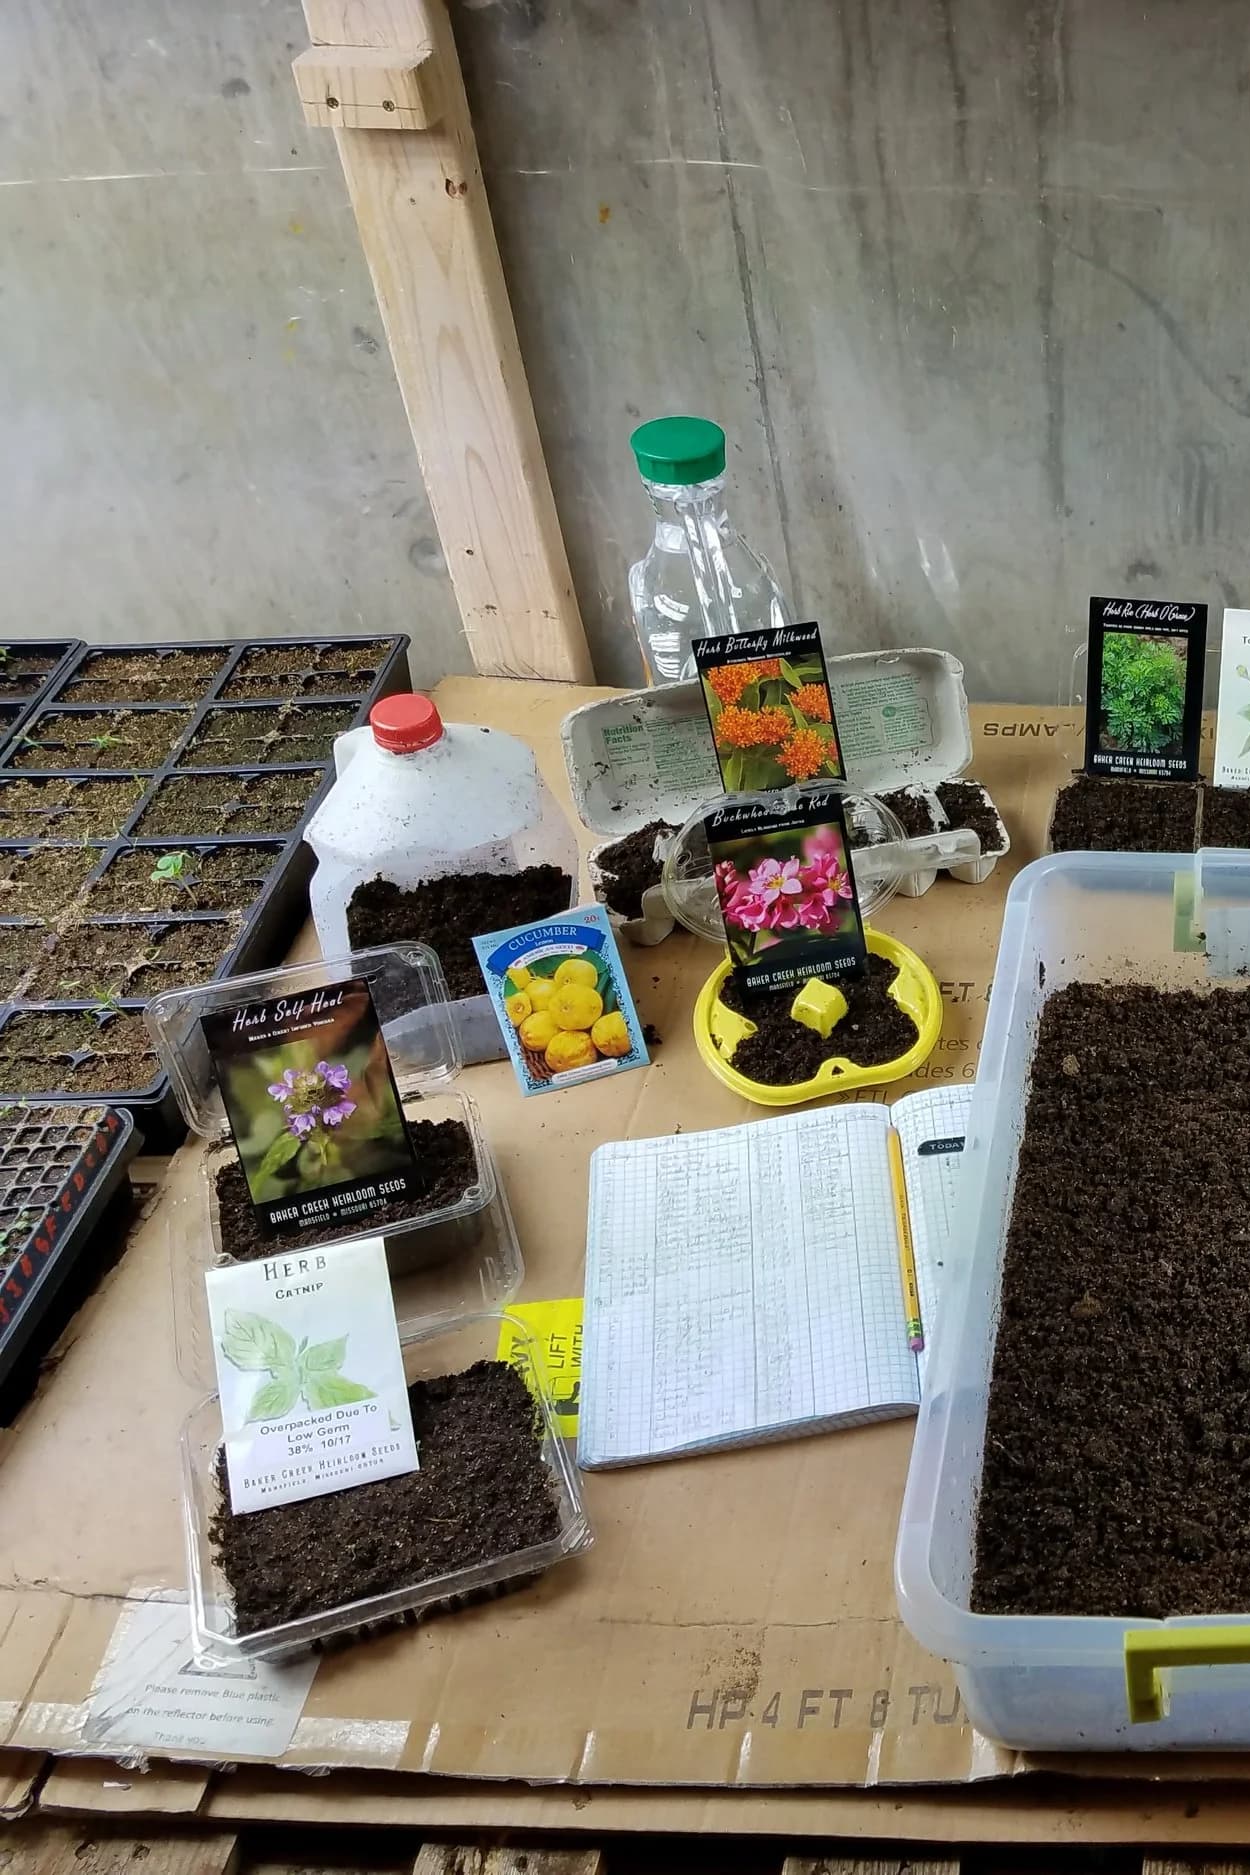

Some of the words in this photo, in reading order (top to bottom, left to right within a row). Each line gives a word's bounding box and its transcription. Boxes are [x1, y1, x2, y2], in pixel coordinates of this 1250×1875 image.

[725, 635, 768, 654] Butterfly
[772, 628, 818, 647] Milkweed
[508, 926, 577, 951] CUCUMBER
[746, 974, 770, 988] BAKER
[772, 967, 795, 982] CREEK
[796, 961, 833, 976] HEIRLOOM
[834, 956, 856, 969] SEEDS
[232, 1009, 266, 1032] Herb
[274, 999, 304, 1022] Self
[310, 990, 343, 1014] Heal
[269, 1206, 299, 1224] BAKER
[301, 1198, 330, 1215] CREEK
[332, 1186, 377, 1207] HEIRLOOM
[379, 1178, 407, 1195] SEEDS
[263, 1255, 327, 1281] HERB
[275, 1282, 324, 1300] CATNIP
[546, 1332, 568, 1368] LIFT
[260, 1412, 333, 1435] Overpacked
[336, 1409, 360, 1420] Due
[363, 1404, 378, 1414] To
[287, 1431, 314, 1443] Low
[317, 1423, 350, 1436] Germ
[287, 1444, 313, 1456] 38%
[321, 1435, 352, 1449] 10/17
[222, 1689, 246, 1699] Blue
[163, 1708, 207, 1720] reflector
[209, 1711, 244, 1723] before
[686, 1689, 749, 1730] HP
[760, 1691, 782, 1728] 4
[796, 1689, 854, 1729] FT
